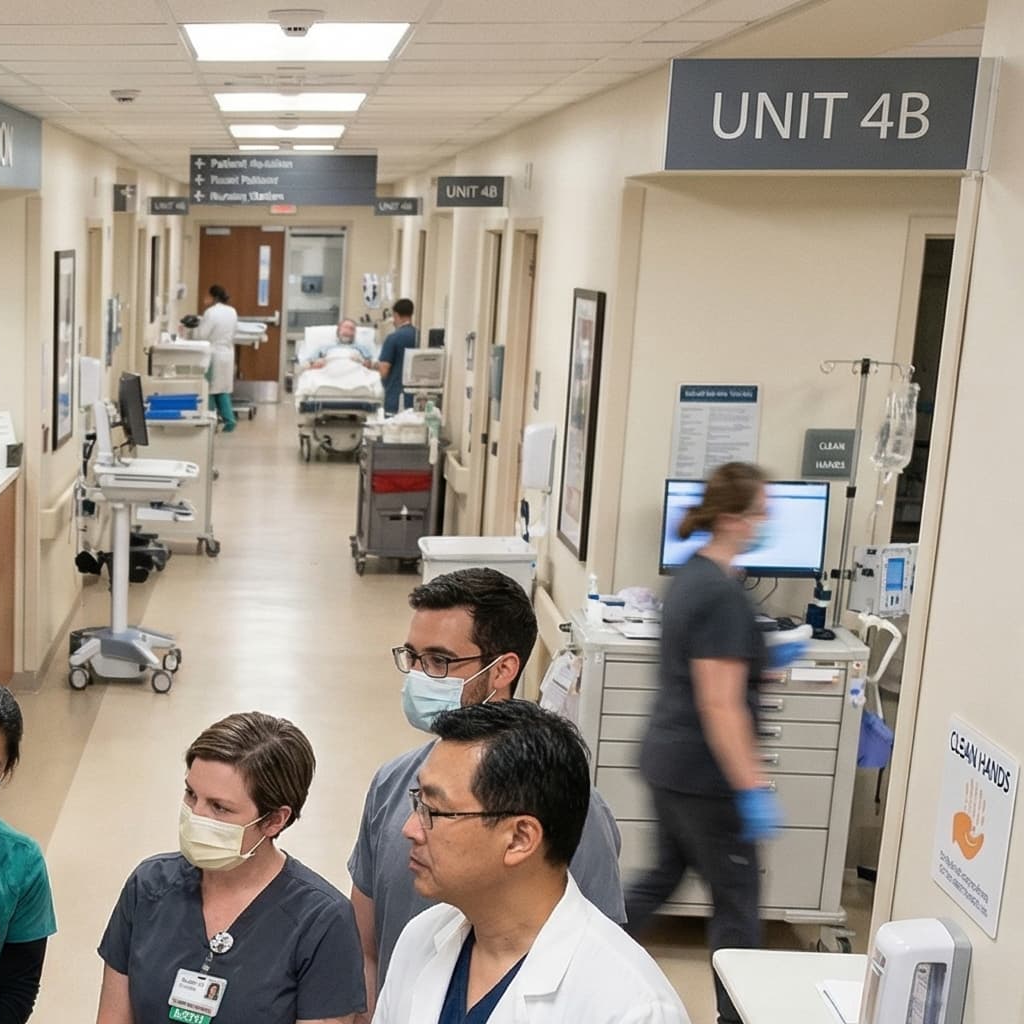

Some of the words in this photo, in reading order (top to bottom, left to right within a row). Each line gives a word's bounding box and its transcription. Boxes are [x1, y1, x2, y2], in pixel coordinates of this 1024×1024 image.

[711, 91, 849, 140] UNIT
[860, 92, 931, 140] 4B
[446, 185, 479, 198] UNIT
[480, 185, 497, 198] 4B
[950, 731, 977, 768] CLEAN
[978, 752, 1011, 793] HANDS
